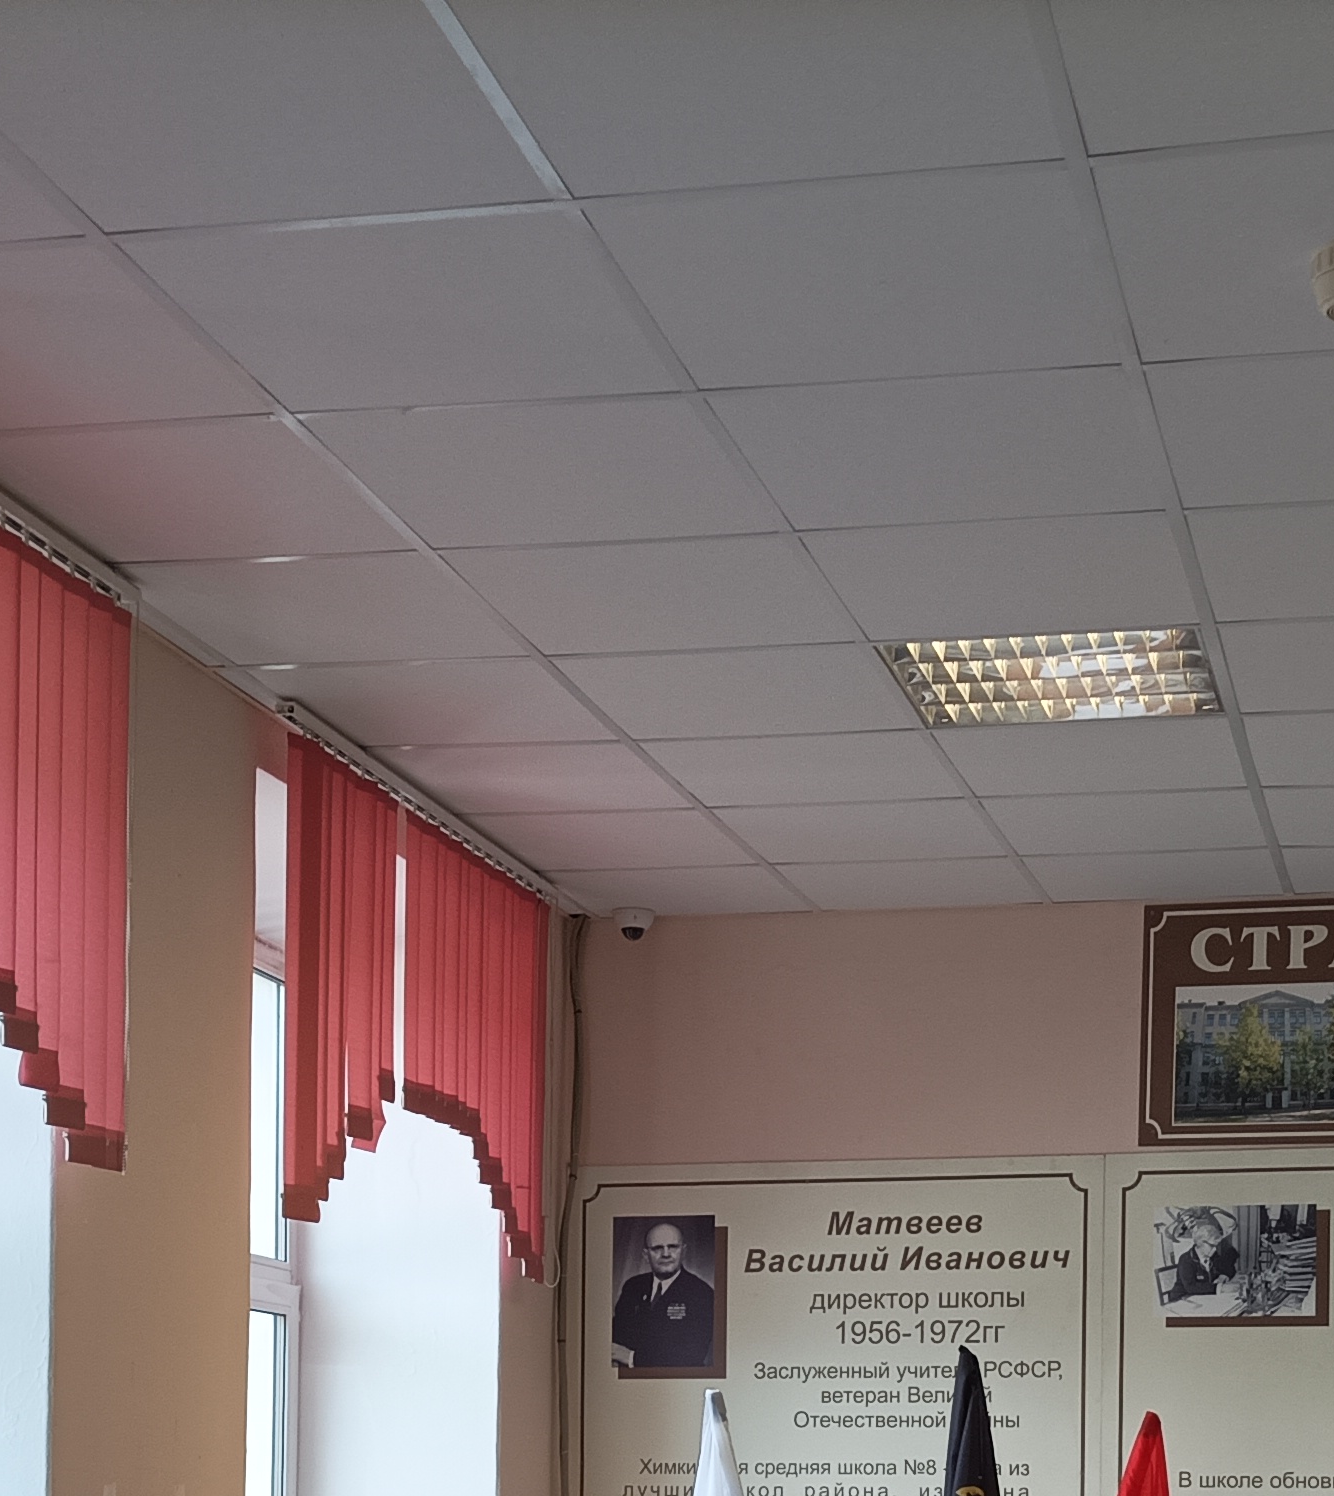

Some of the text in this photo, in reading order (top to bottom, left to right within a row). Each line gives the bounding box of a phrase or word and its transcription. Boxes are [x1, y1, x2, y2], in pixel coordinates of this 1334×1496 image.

[827, 1210, 983, 1236] Матвеев
[744, 1245, 1071, 1273] Василий Иванович
[809, 1290, 1025, 1316] директор школы
[835, 1319, 1006, 1345] 1956-1972гг
[753, 1360, 1063, 1384] Заслуженный РСФСР,
[820, 1389, 901, 1408] ветеран
[793, 1410, 947, 1429] Отечественной
[754, 1458, 1030, 1479] средняя школа №8 из
[1178, 1470, 1193, 1489] В
[1199, 1474, 1264, 1489] школе
